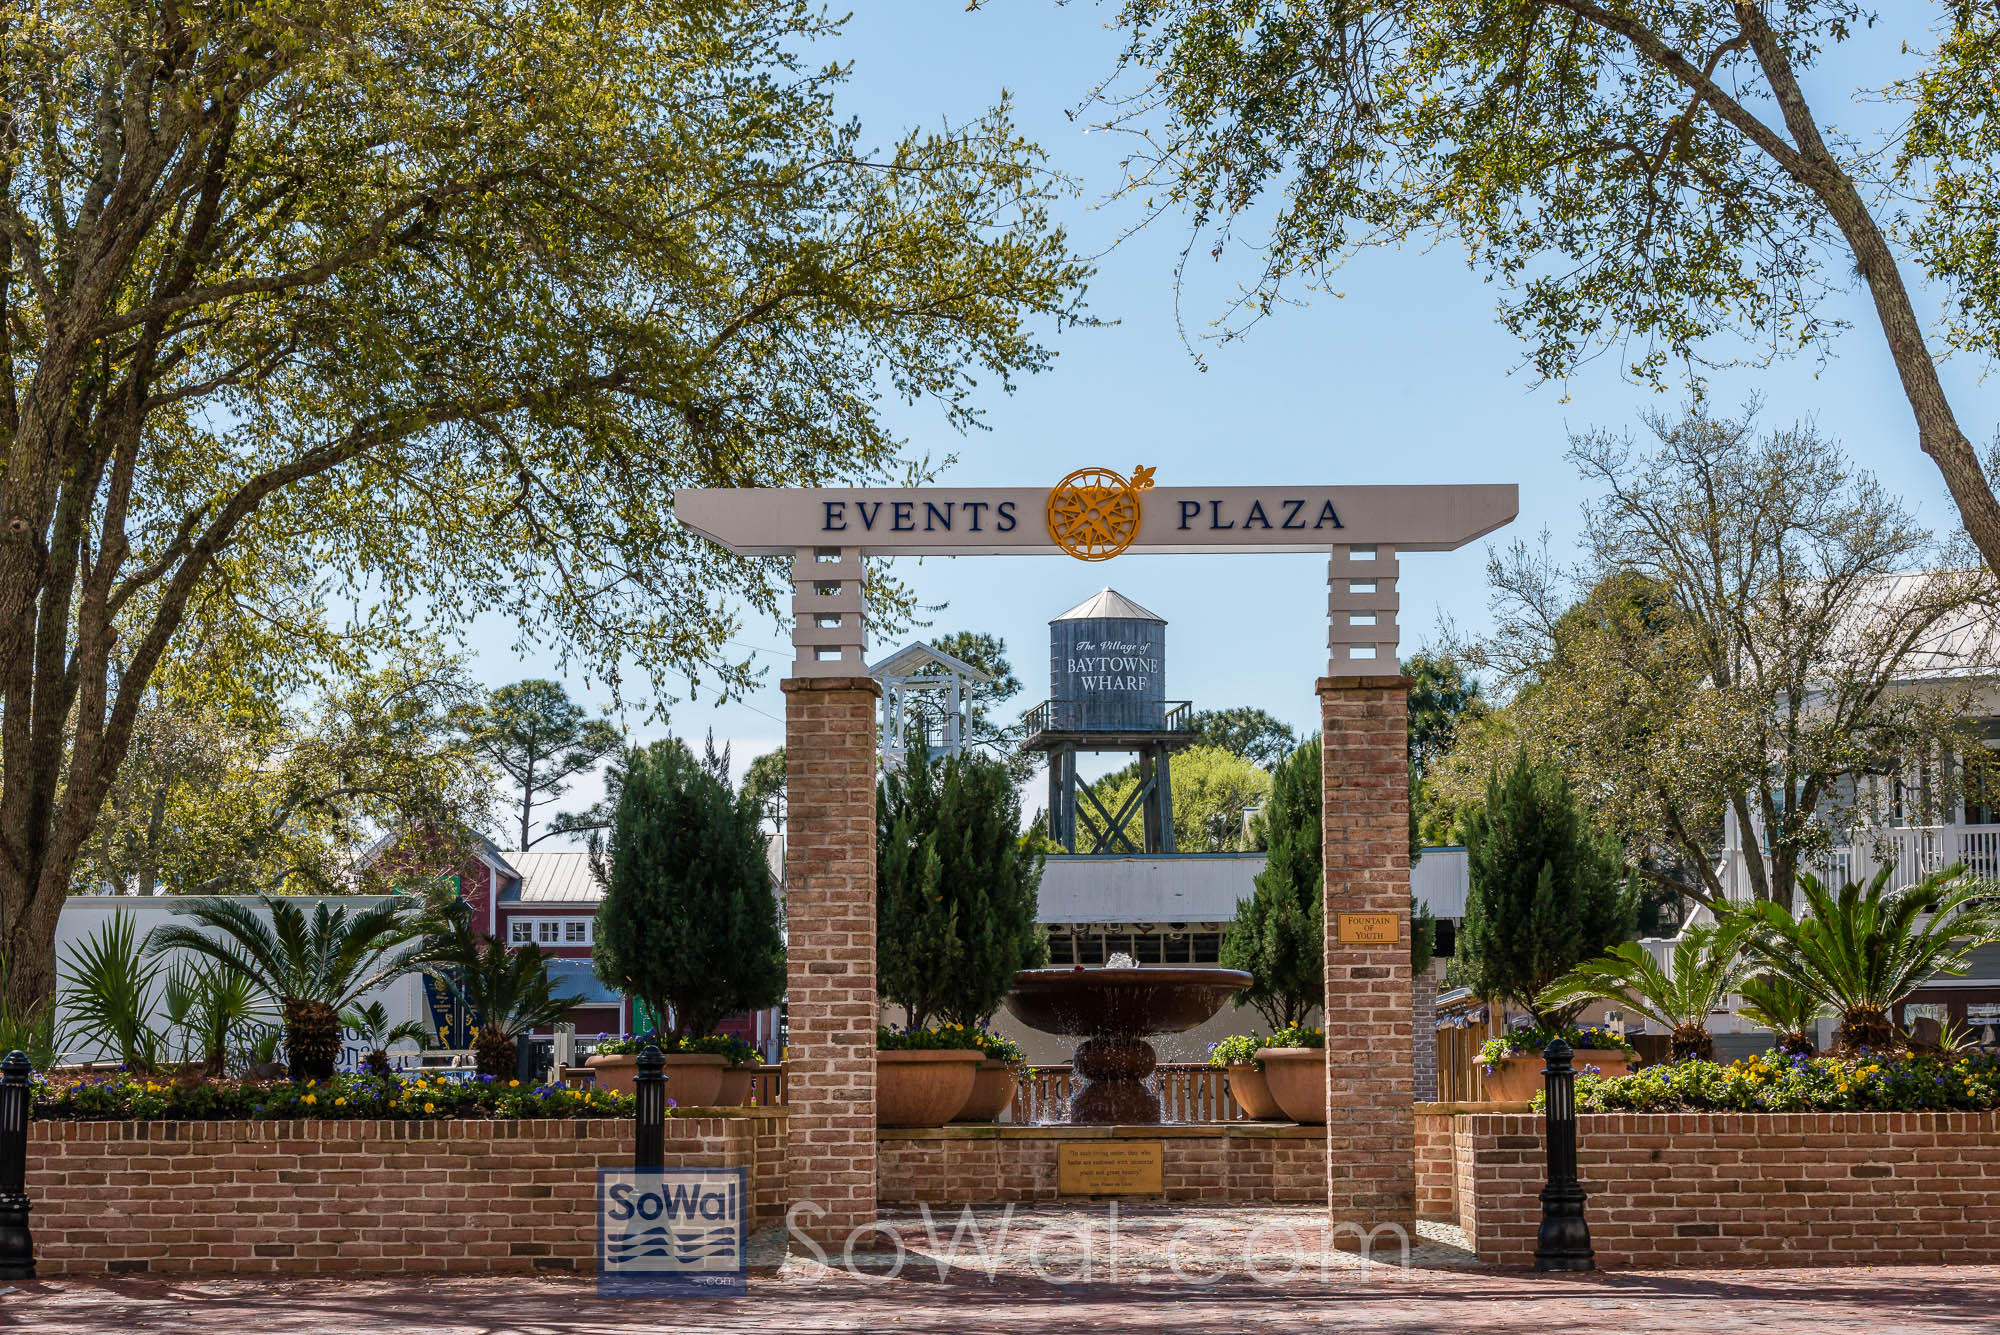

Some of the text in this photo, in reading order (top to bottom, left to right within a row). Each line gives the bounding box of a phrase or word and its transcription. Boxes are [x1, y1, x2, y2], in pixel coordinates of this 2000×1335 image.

[821, 499, 1345, 532] EVENTS PLAZA
[1076, 641, 1151, 654] The Village of
[1067, 657, 1158, 673] BAYTOWNE
[1081, 675, 1147, 691] WHARF
